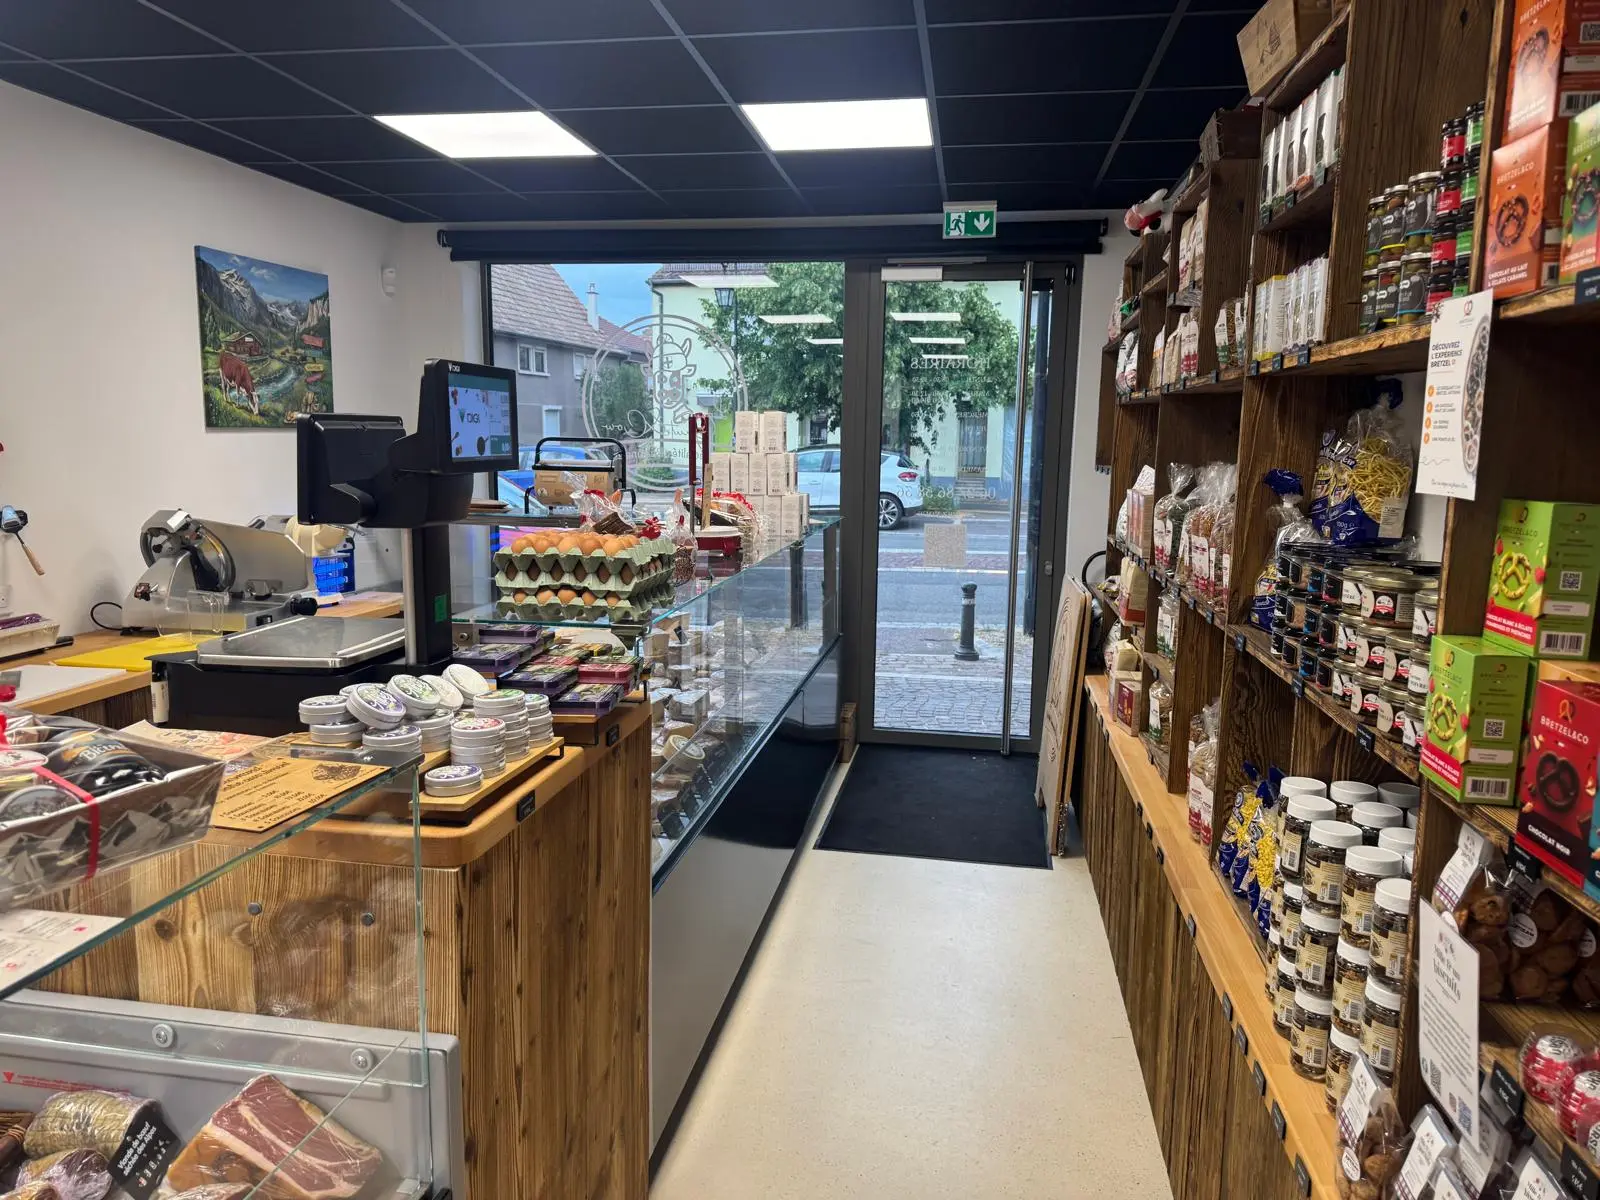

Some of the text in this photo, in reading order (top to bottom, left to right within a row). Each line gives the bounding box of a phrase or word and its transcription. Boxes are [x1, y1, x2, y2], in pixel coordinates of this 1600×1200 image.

[1496, 162, 1535, 185] BRETZEL&CO
[1488, 267, 1510, 280] CHOCOLAT
[1517, 262, 1528, 272] LAIT
[1507, 271, 1528, 282] CARAMEL
[1431, 340, 1461, 351] DÉCOUVREZ
[1430, 360, 1451, 369] BRETZEL
[466, 412, 481, 424] DIGI
[1540, 714, 1590, 746] BRETZEL&CO
[1528, 823, 1572, 857] CHOCOLAT NOIR
[117, 1146, 136, 1171] Viande
[130, 1138, 141, 1150] de
[121, 1153, 140, 1177] séchée
[134, 1140, 148, 1156] des
[143, 1125, 159, 1145] Alpes
